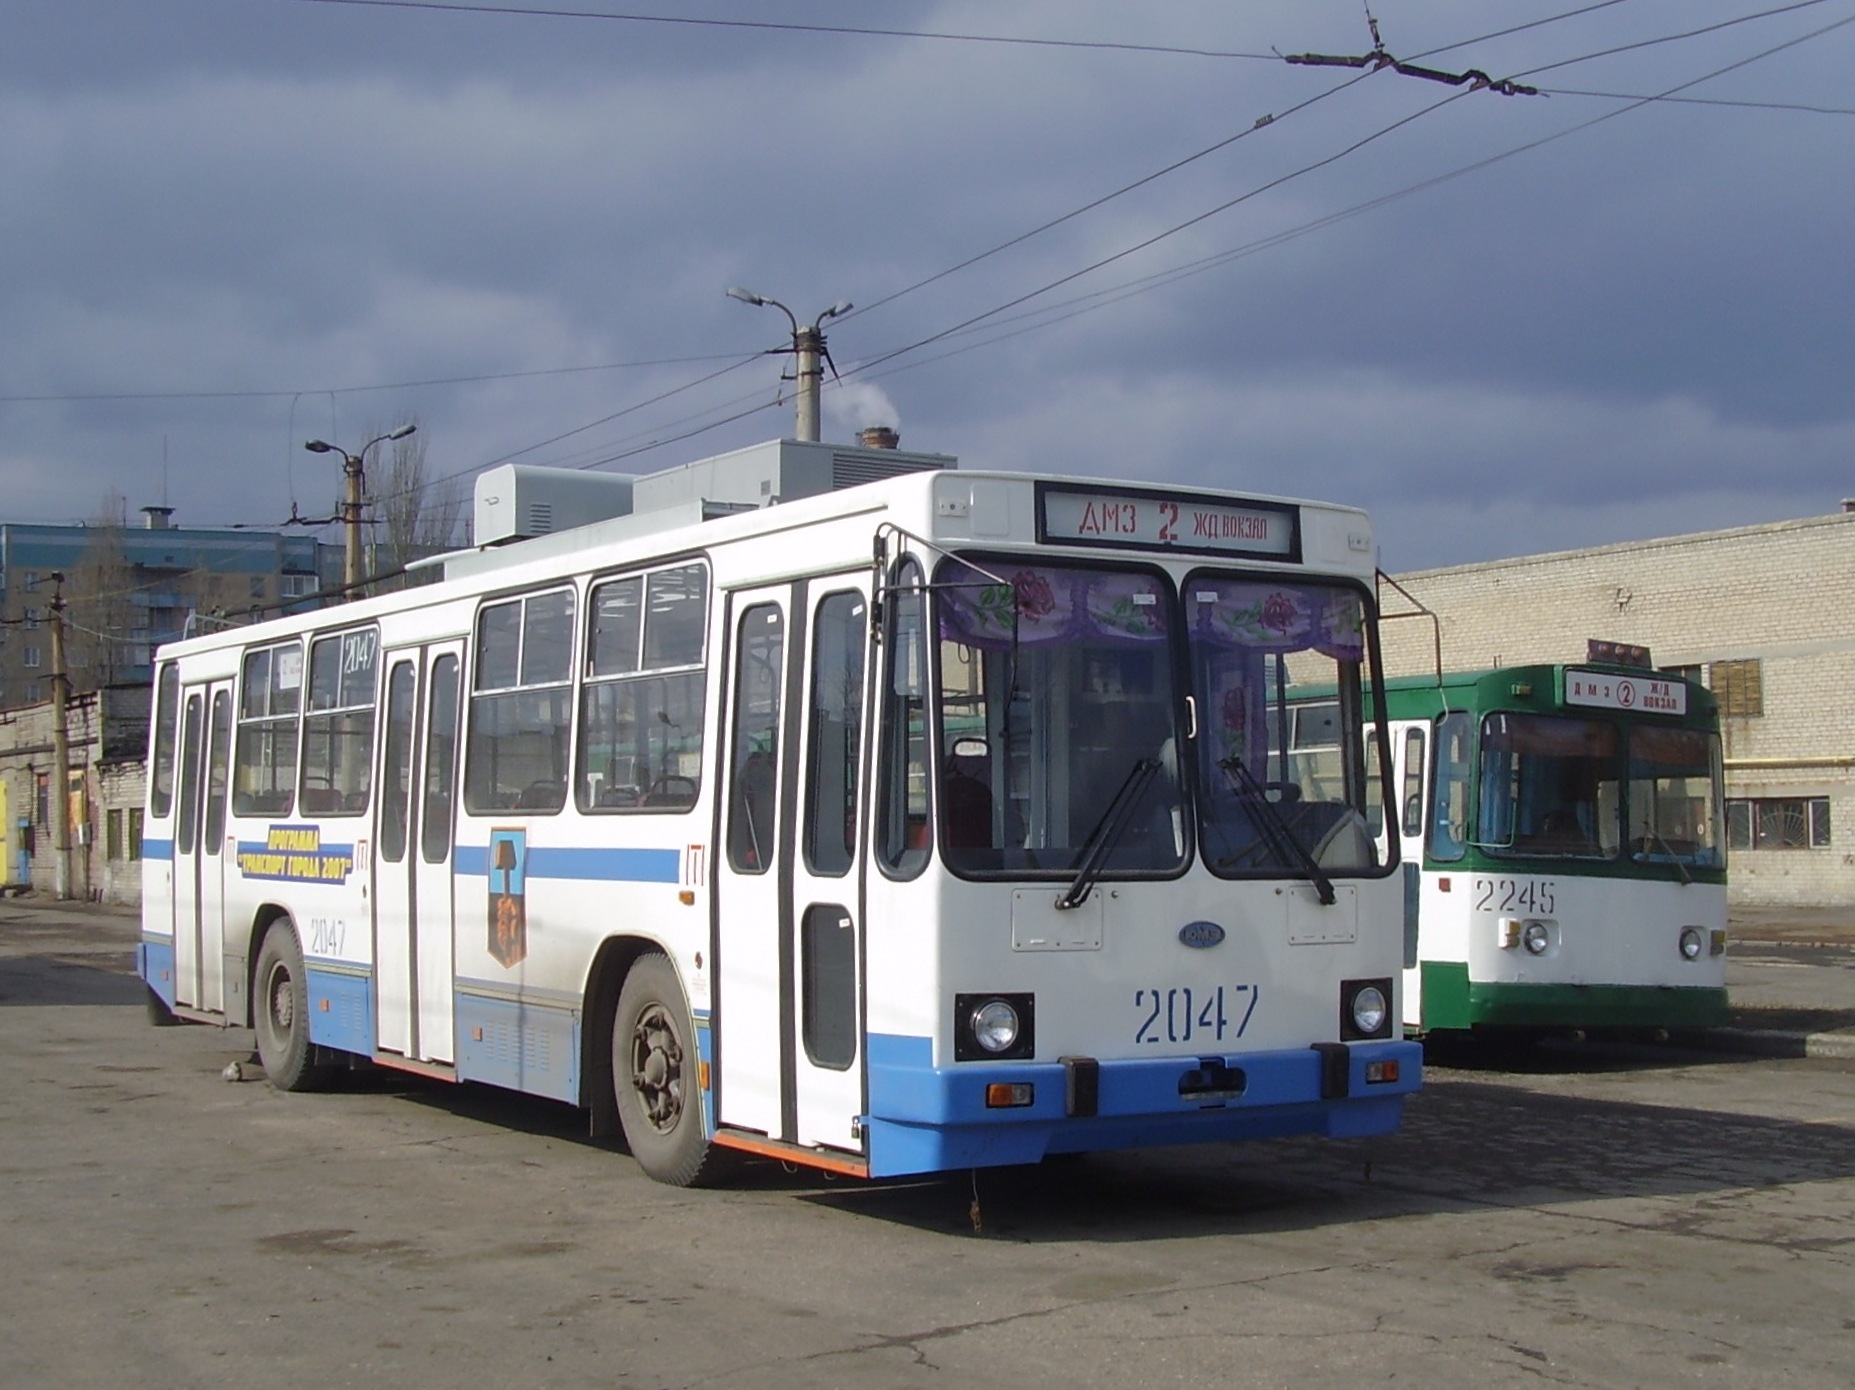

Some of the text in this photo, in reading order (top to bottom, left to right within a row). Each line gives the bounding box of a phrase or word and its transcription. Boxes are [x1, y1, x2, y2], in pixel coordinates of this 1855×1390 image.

[1079, 501, 1137, 535] ДМЗ
[1158, 502, 1179, 541] 2
[1222, 514, 1268, 540] ВОКЗАЛ
[344, 632, 377, 674] 2047
[1643, 696, 1678, 710] ВОКЗАЛ
[268, 829, 319, 852] ПРОГРАММА
[1476, 880, 1554, 914] 2245
[311, 918, 346, 956] 2047
[1136, 985, 1259, 1044] 2047
